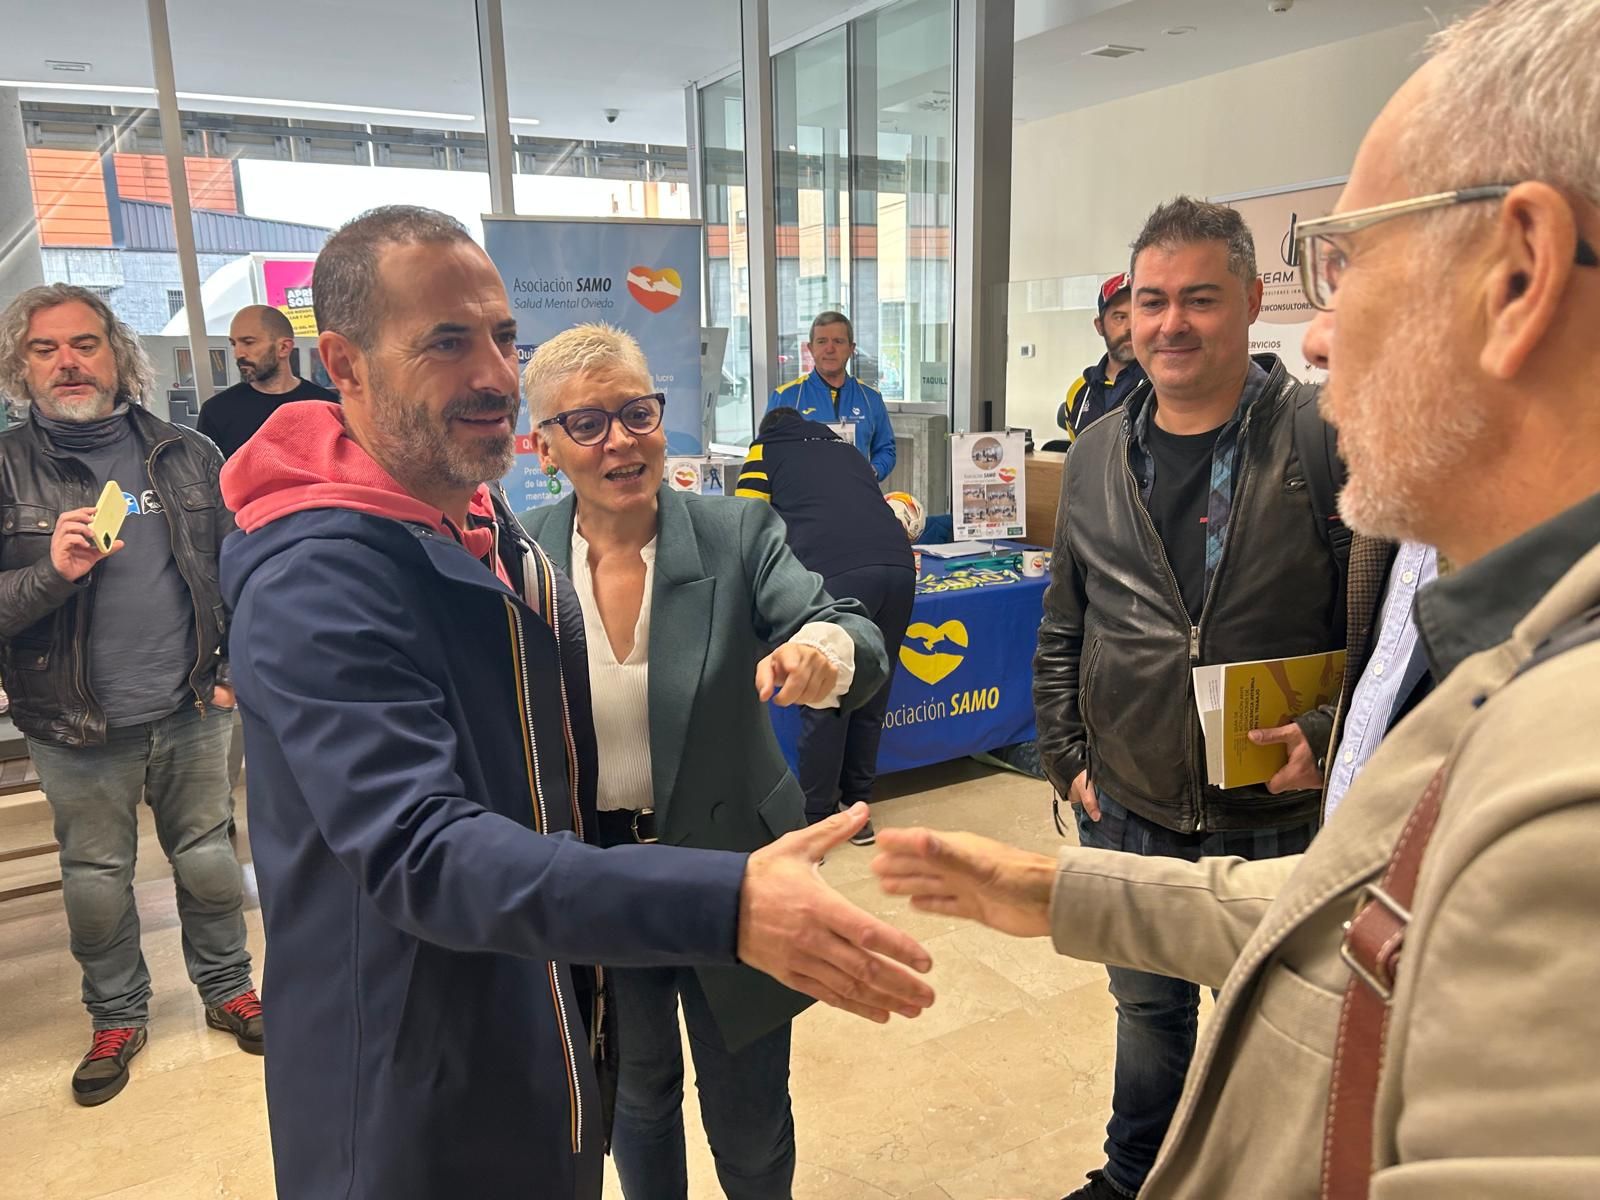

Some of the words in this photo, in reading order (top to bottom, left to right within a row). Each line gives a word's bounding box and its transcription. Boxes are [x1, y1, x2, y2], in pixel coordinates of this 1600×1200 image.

[513, 276, 573, 293] Asociación
[576, 277, 612, 292] SAMO
[514, 297, 542, 310] Salud
[544, 297, 579, 310] Mental
[581, 297, 615, 310] Oviedo
[950, 686, 1000, 716] SAMO
